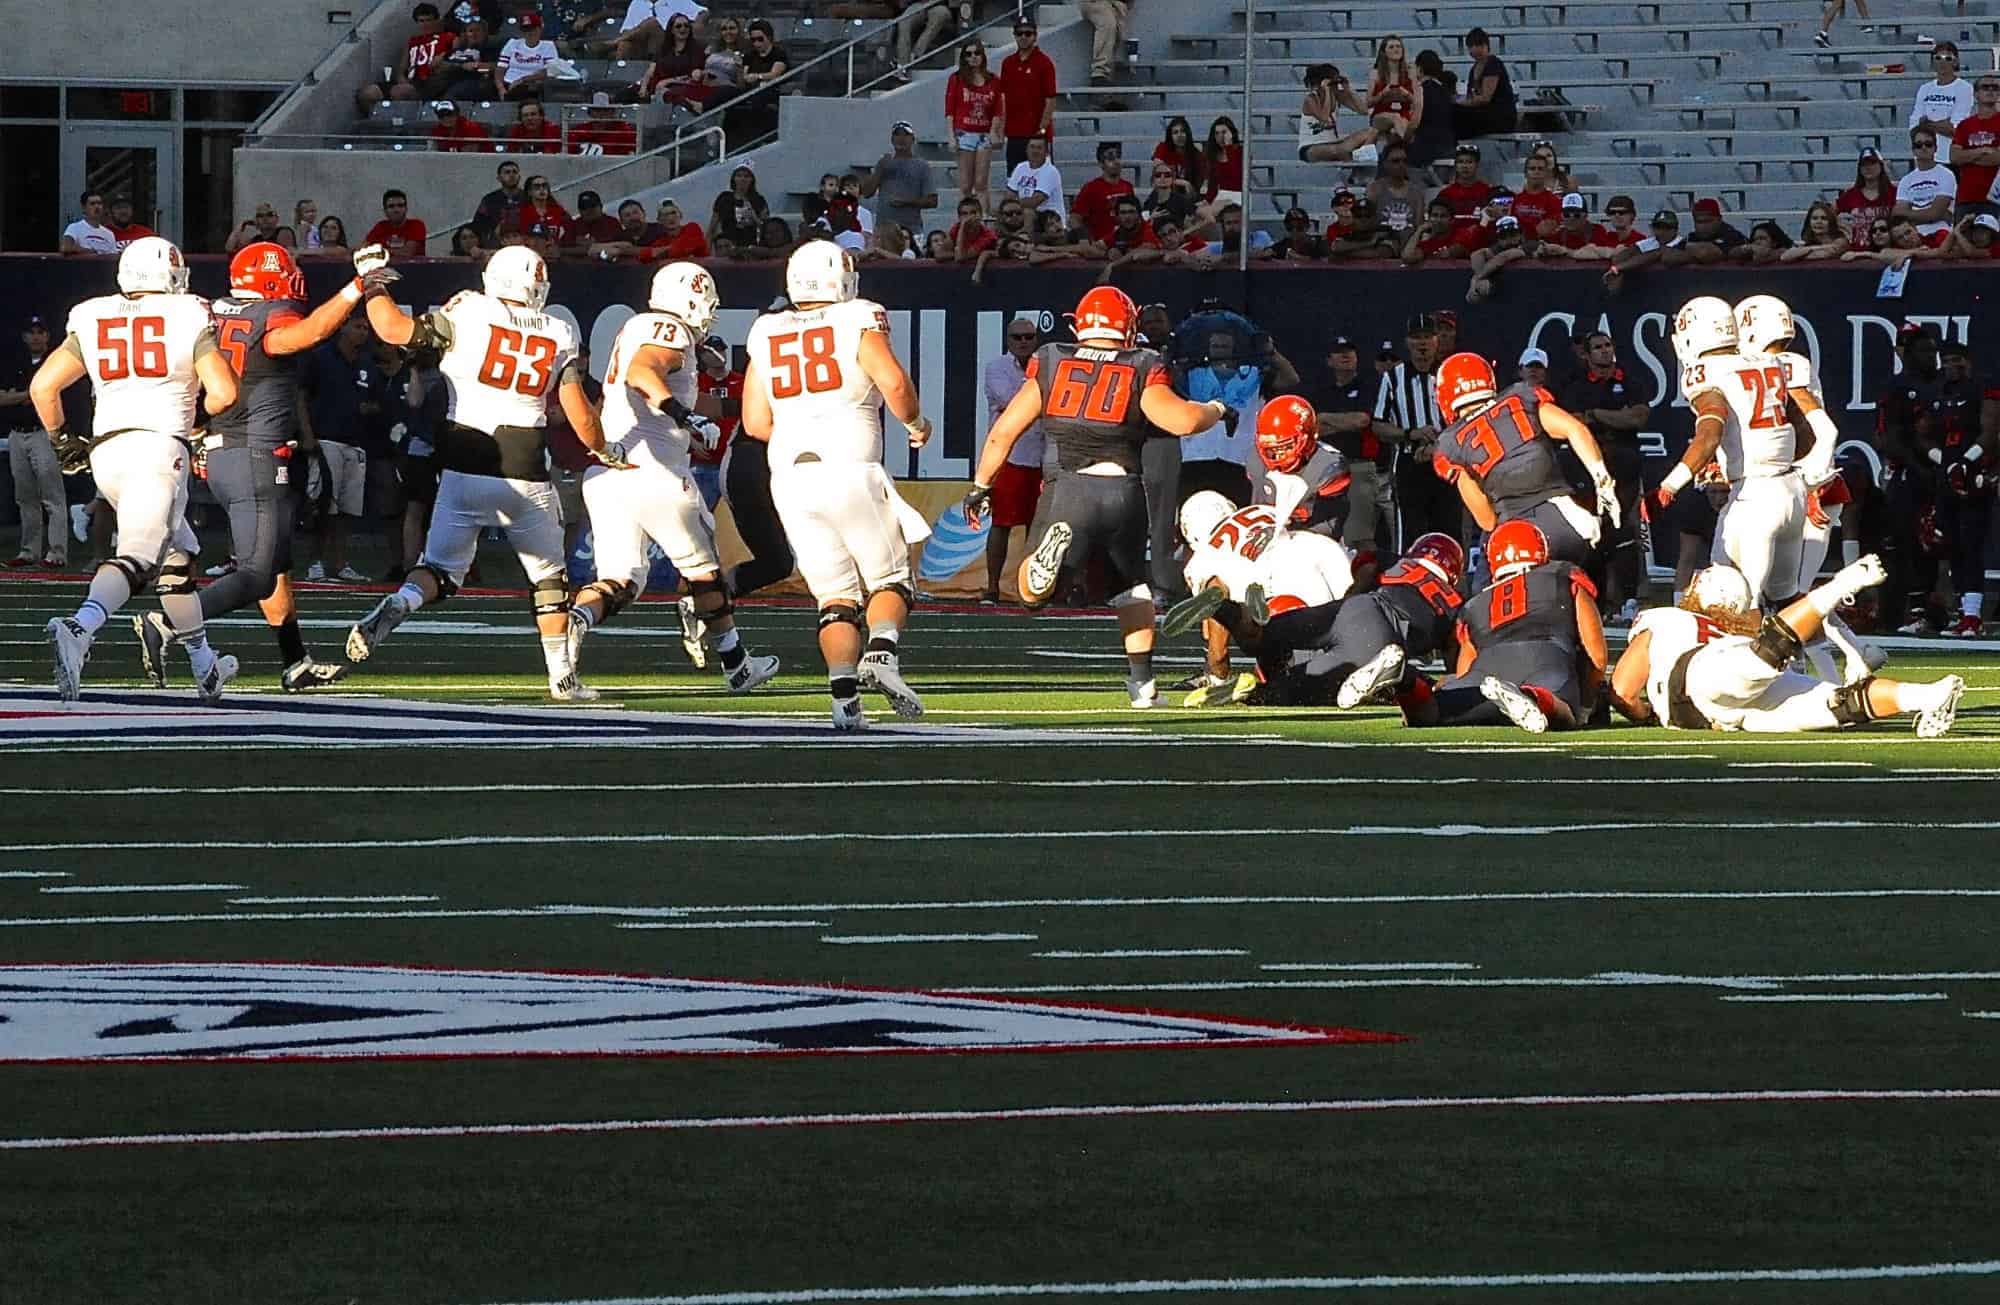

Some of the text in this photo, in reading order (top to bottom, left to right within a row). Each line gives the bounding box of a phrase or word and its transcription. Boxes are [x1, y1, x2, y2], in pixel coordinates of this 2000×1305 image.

[97, 315, 169, 381] 56
[213, 317, 252, 378] 5
[478, 323, 558, 398] 63
[653, 321, 678, 343] 73
[768, 325, 843, 400] 58
[1046, 358, 1136, 425] 60
[1685, 364, 1706, 388] 23
[1736, 366, 1788, 429] 23
[1456, 394, 1536, 478] 37
[1488, 572, 1528, 631] 8
[864, 654, 890, 666] NIKE
